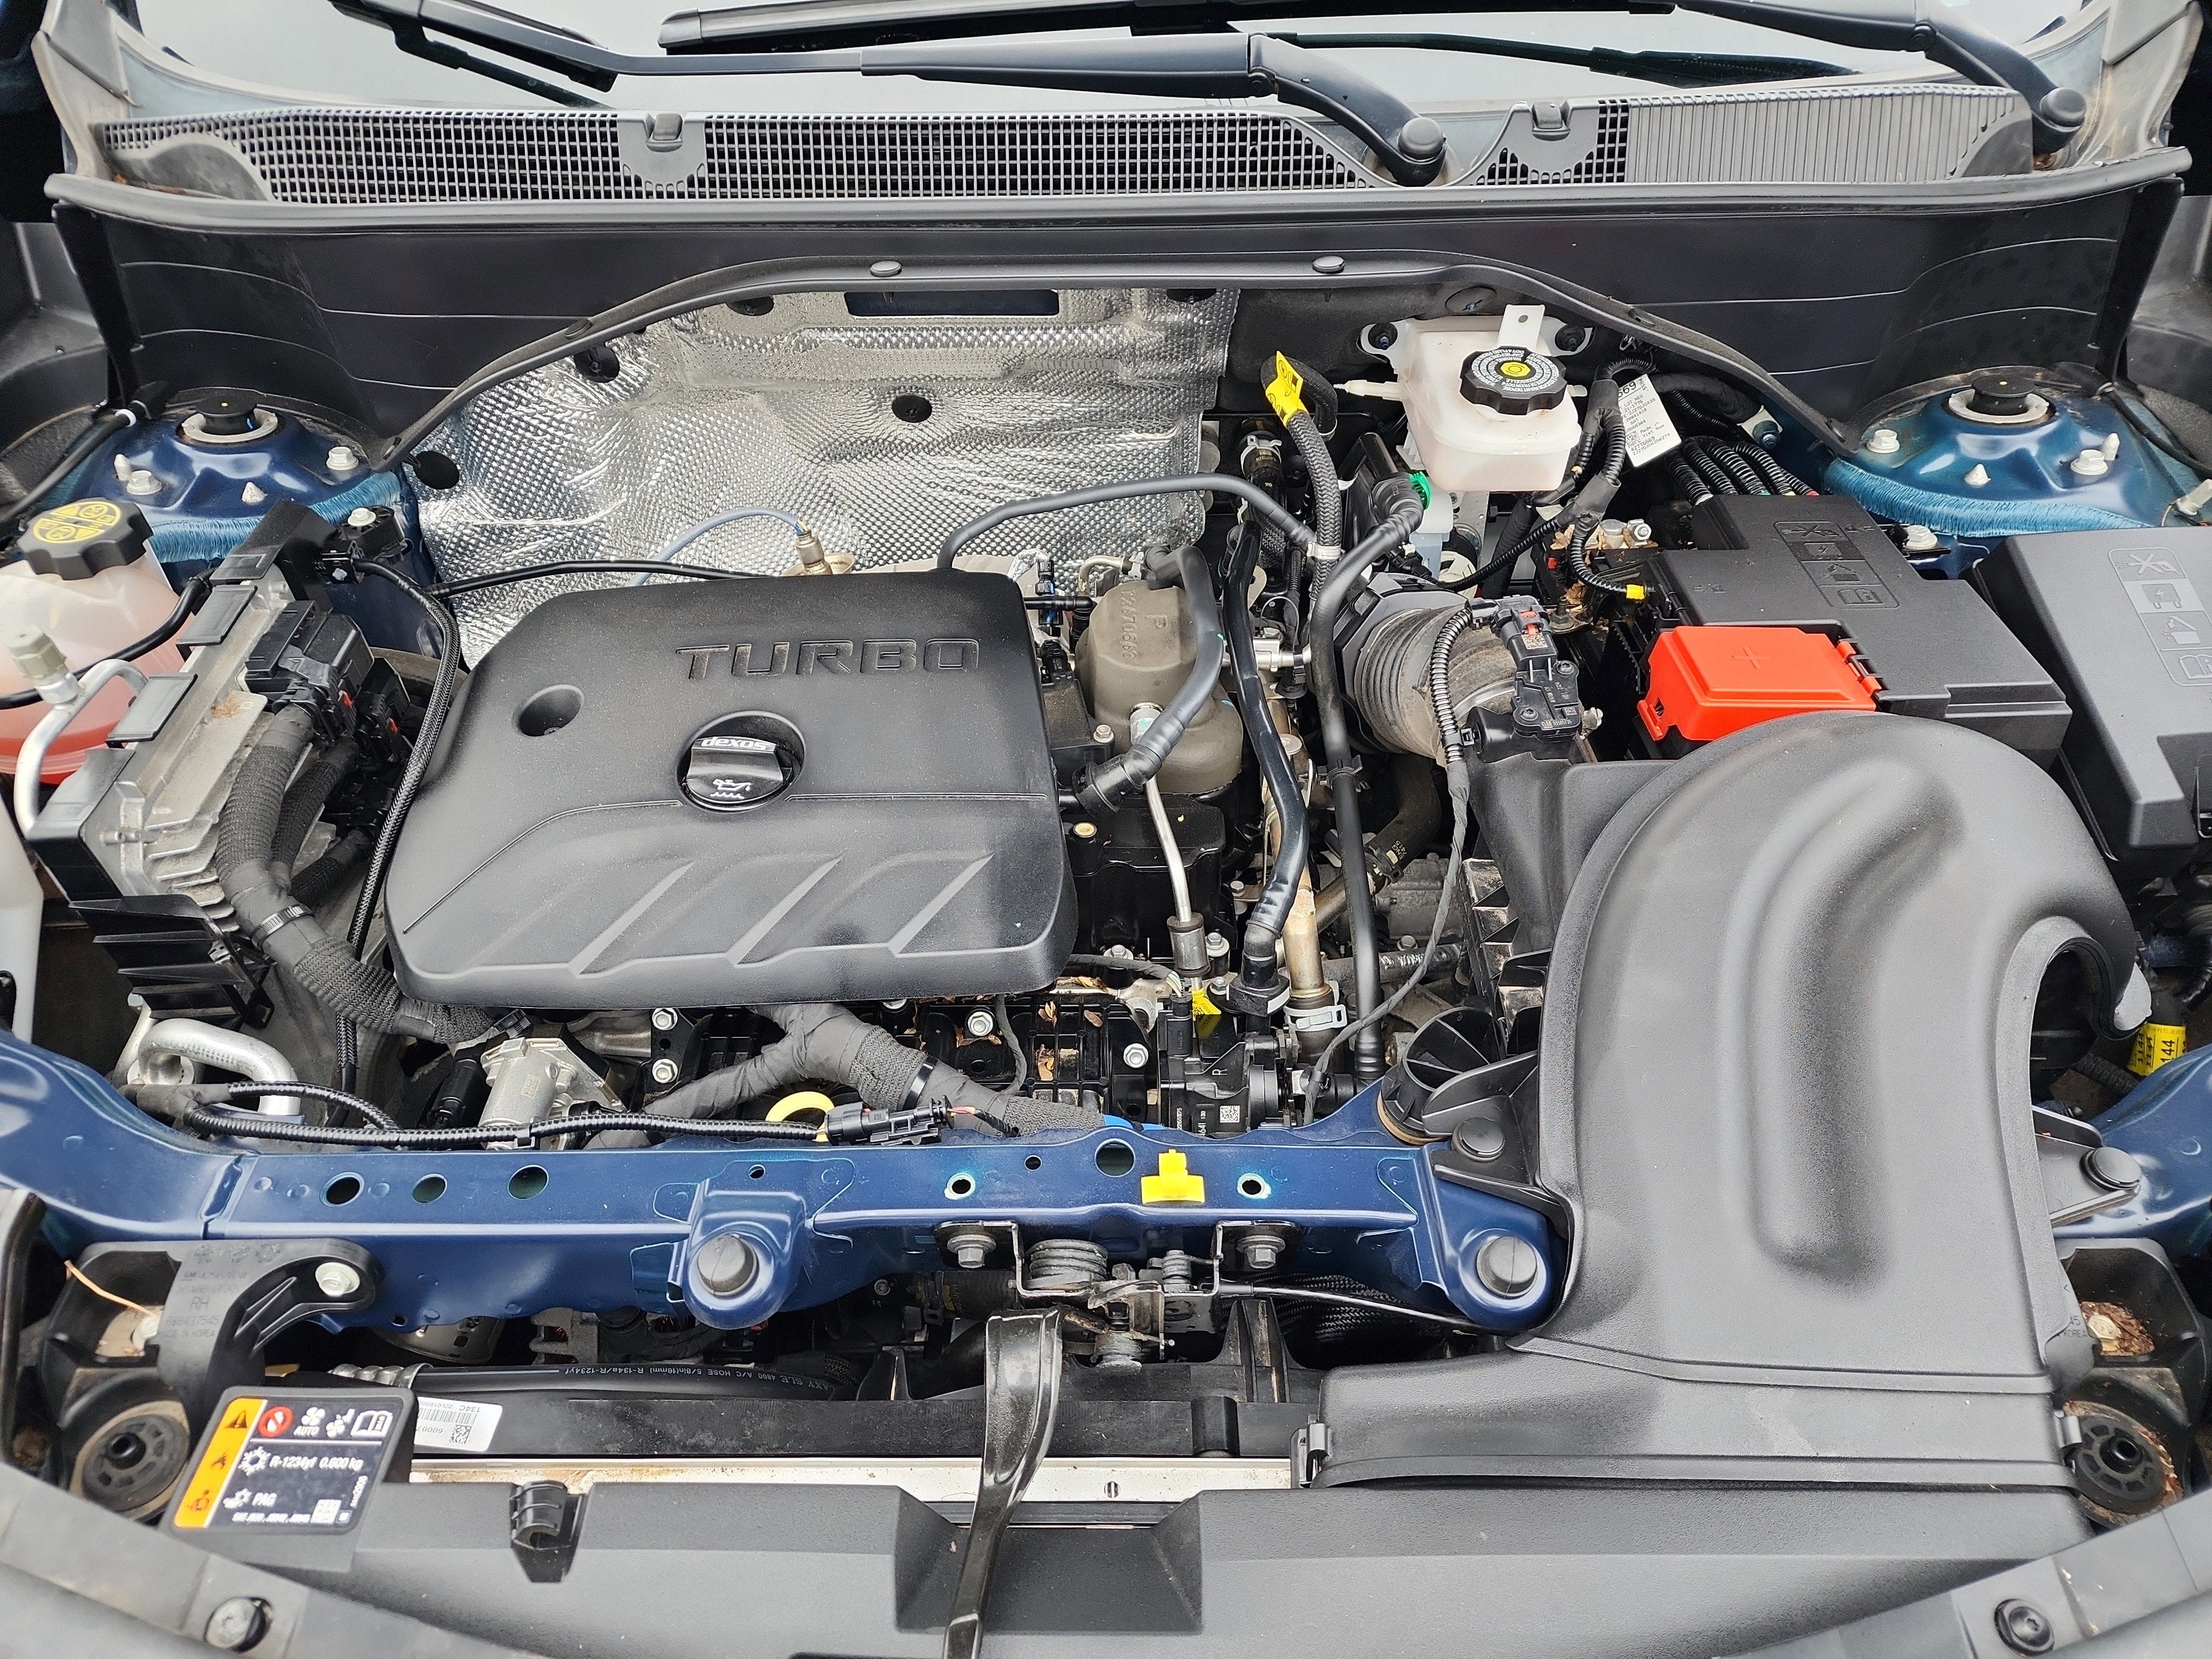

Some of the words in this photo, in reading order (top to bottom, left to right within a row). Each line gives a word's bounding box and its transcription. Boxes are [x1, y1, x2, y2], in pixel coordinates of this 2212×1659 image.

[1145, 614, 1168, 630] R
[676, 638, 980, 680] TURBO
[701, 736, 768, 750] dexos
[190, 1297, 210, 1310] RH
[192, 1328, 215, 1338] KOREA
[2064, 1329, 2088, 1338] KOREA
[780, 1375, 802, 1385] SLE
[294, 1426, 320, 1436] AUTO
[269, 1455, 317, 1470] R-1234yf
[348, 1457, 364, 1472] kg
[252, 1493, 277, 1507] PAG
